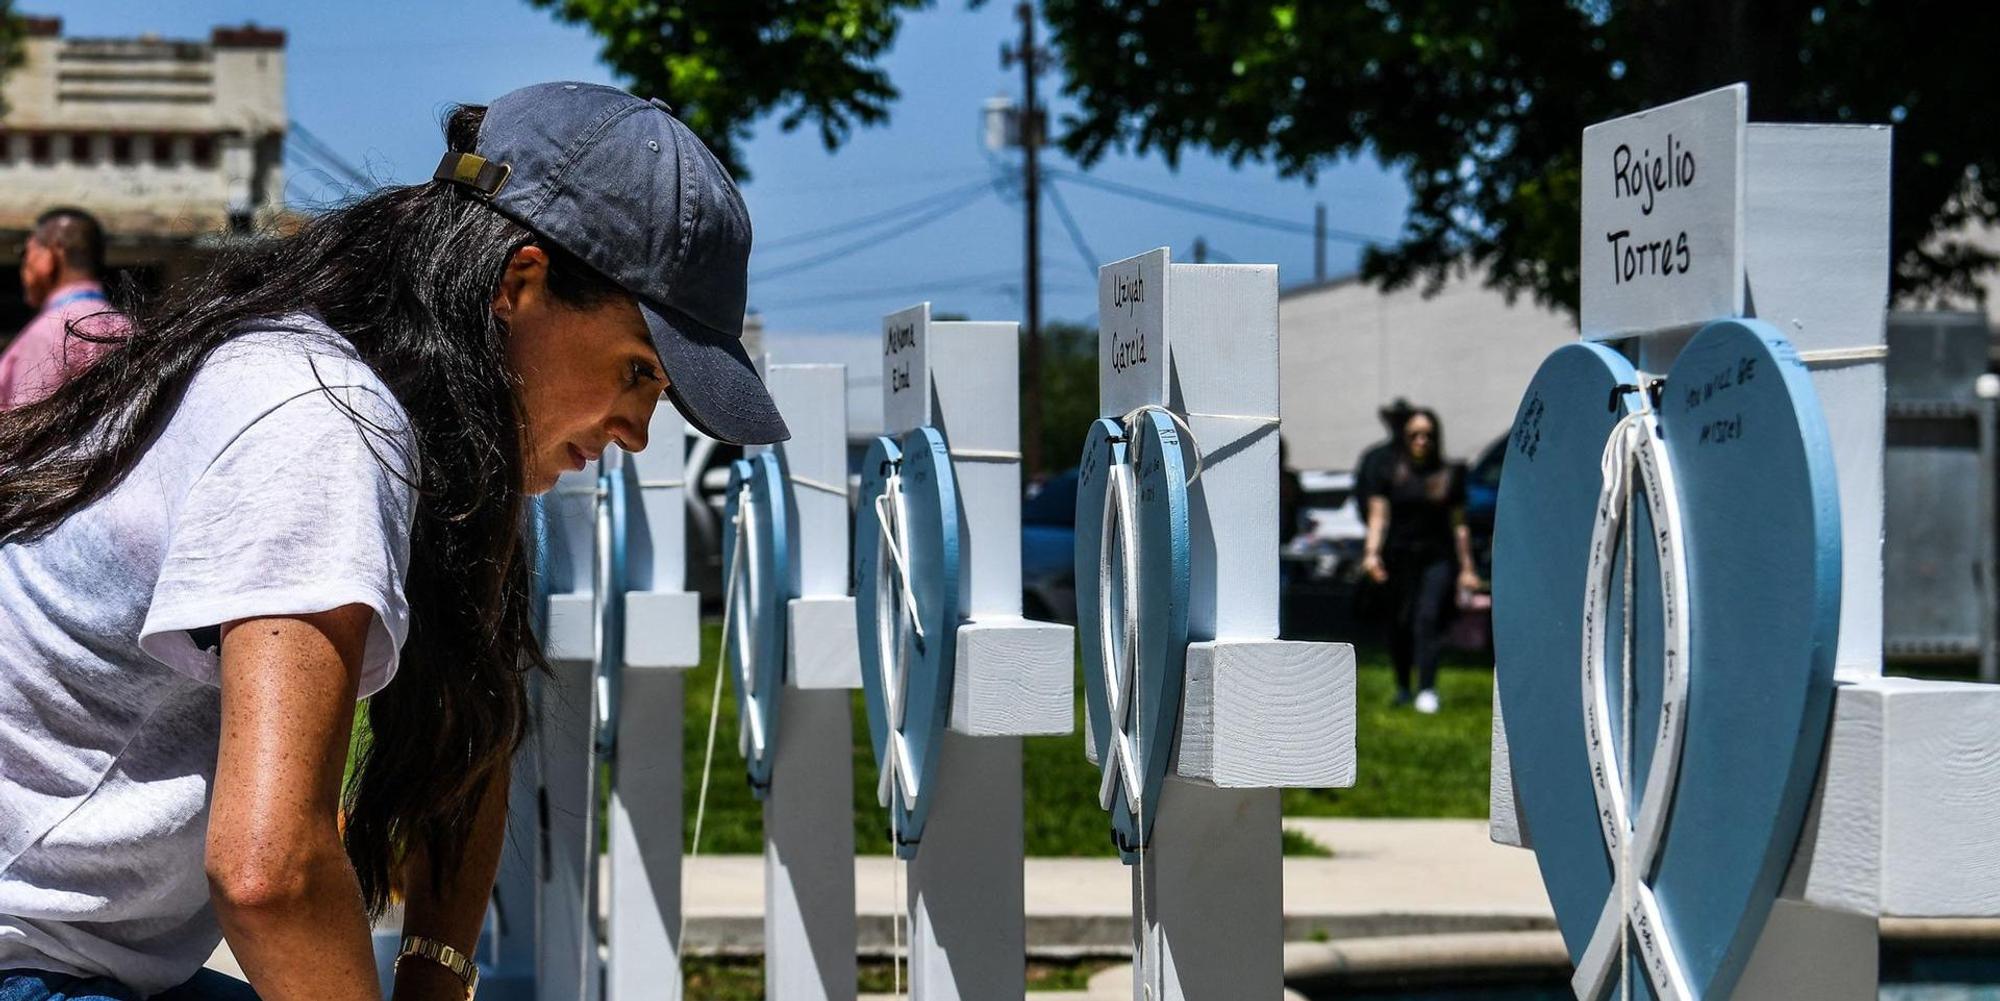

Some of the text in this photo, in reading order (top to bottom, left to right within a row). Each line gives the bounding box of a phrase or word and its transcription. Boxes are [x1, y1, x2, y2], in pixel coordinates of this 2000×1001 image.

[1613, 133, 1696, 215] Rojelio
[1607, 229, 1690, 285] Torres
[1113, 263, 1145, 318] Uziyah
[1111, 327, 1147, 374] Garcia
[1158, 427, 1179, 447] RIP
